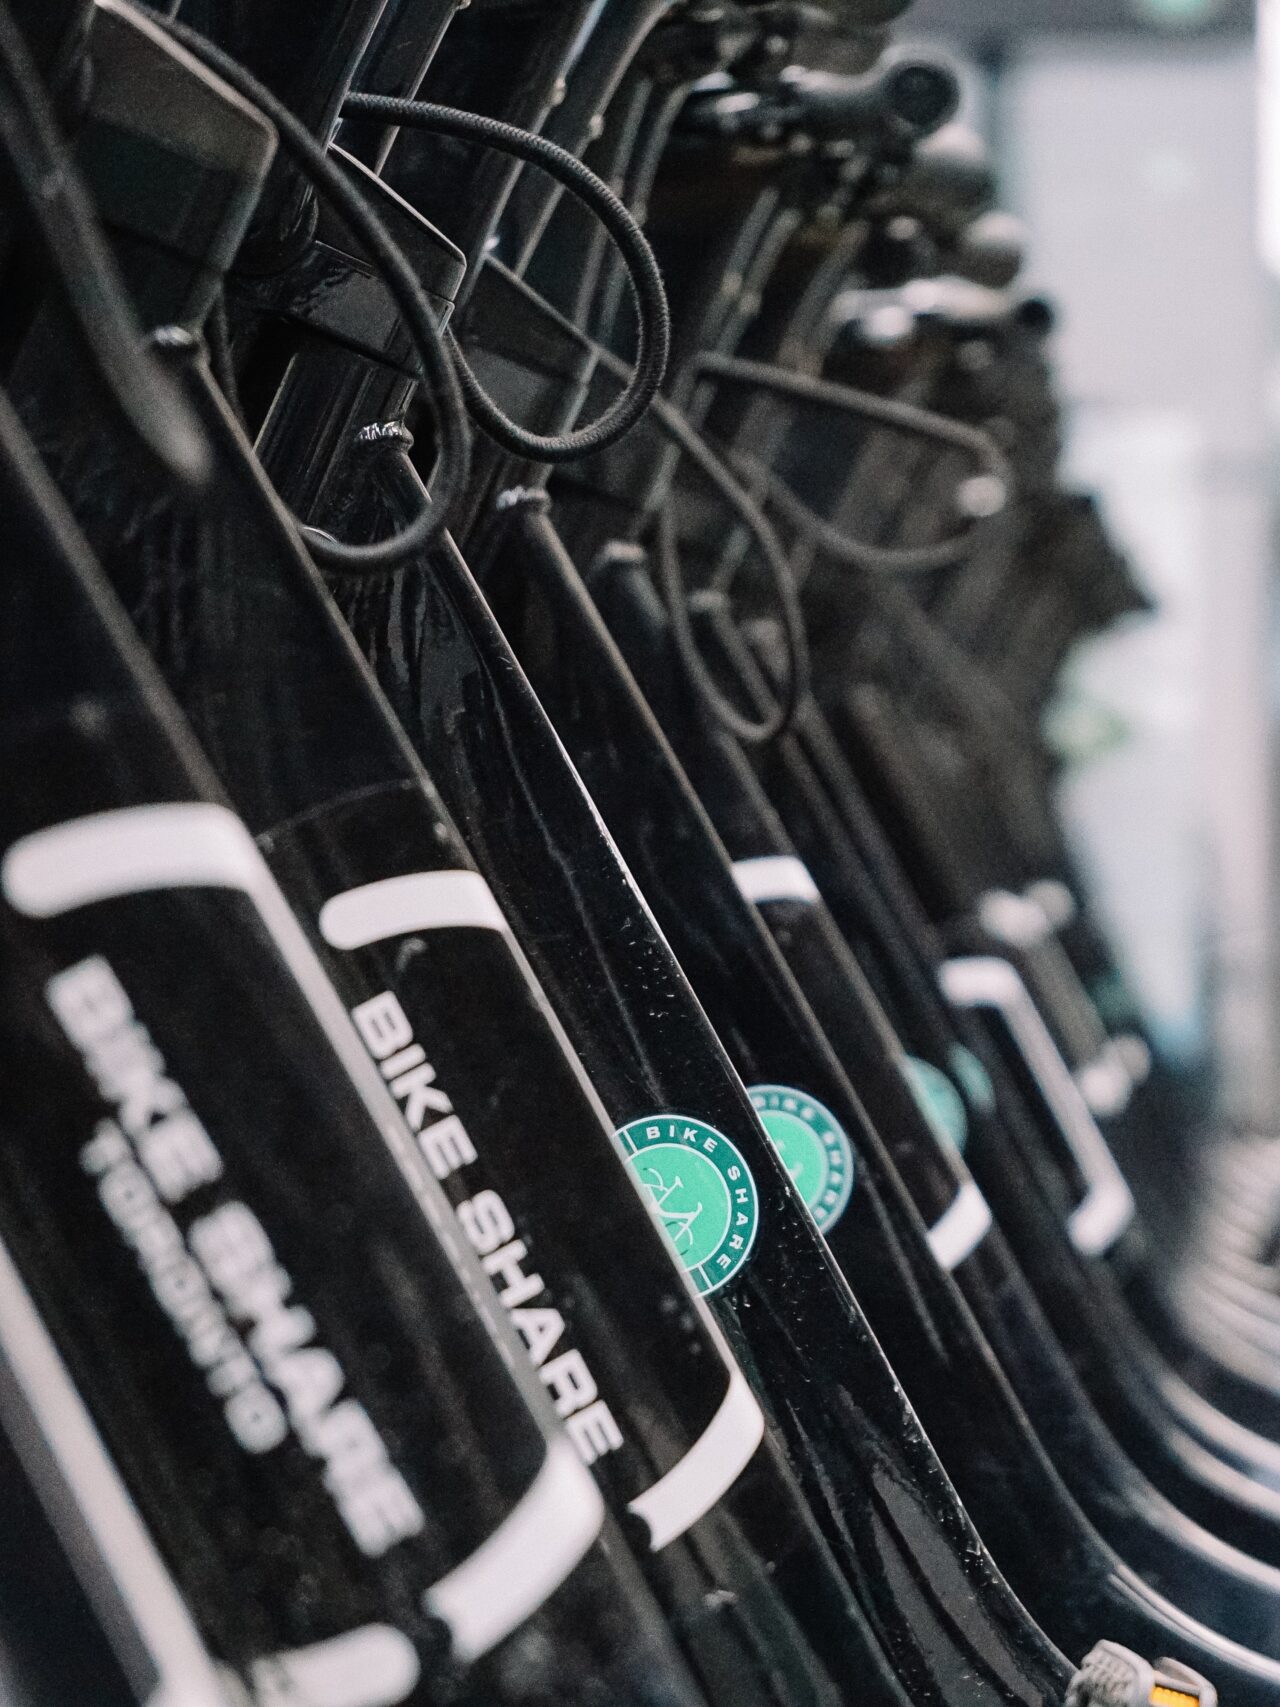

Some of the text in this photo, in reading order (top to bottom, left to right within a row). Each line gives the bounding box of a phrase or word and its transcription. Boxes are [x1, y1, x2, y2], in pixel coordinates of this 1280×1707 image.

[350, 989, 625, 1464] BIKE SHARE
[645, 1124, 750, 1270] BIKE SHARE
